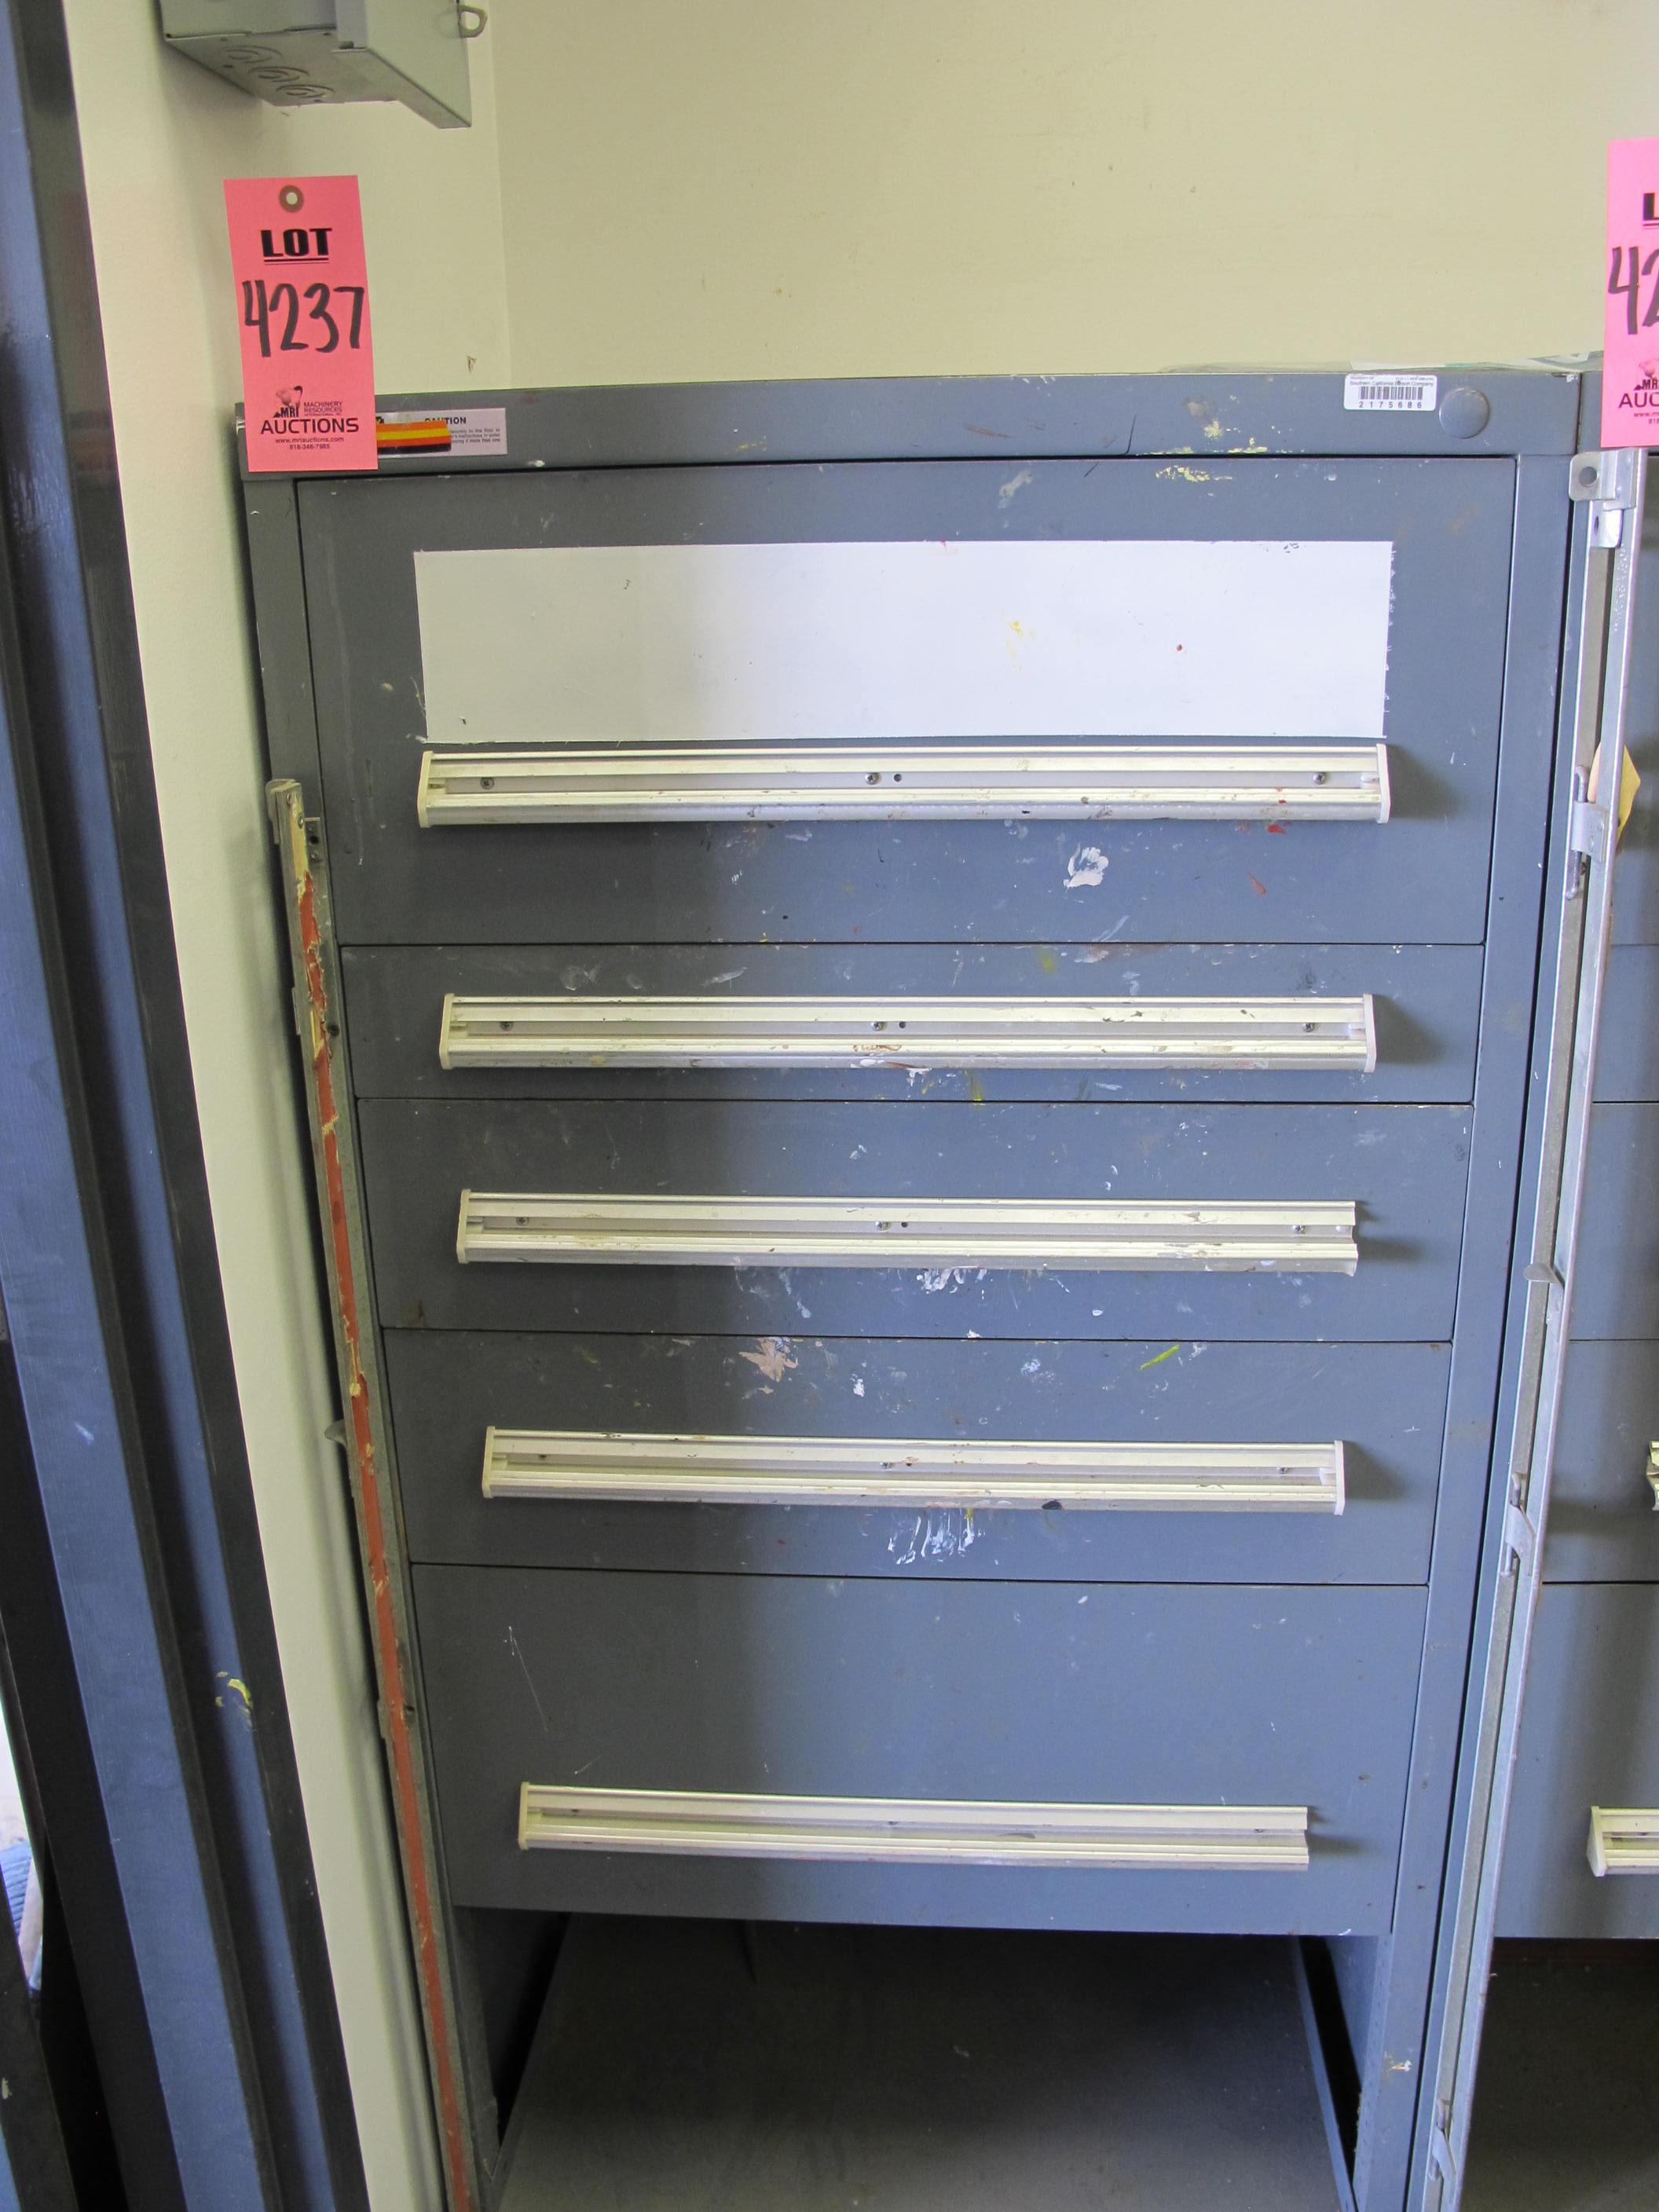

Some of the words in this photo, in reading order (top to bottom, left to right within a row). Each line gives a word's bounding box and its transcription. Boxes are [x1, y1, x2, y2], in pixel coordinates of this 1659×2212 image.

[260, 228, 332, 258] LOT
[242, 280, 364, 357] 4237
[280, 406, 298, 418] MRI
[260, 417, 360, 434] AUCTIONS
